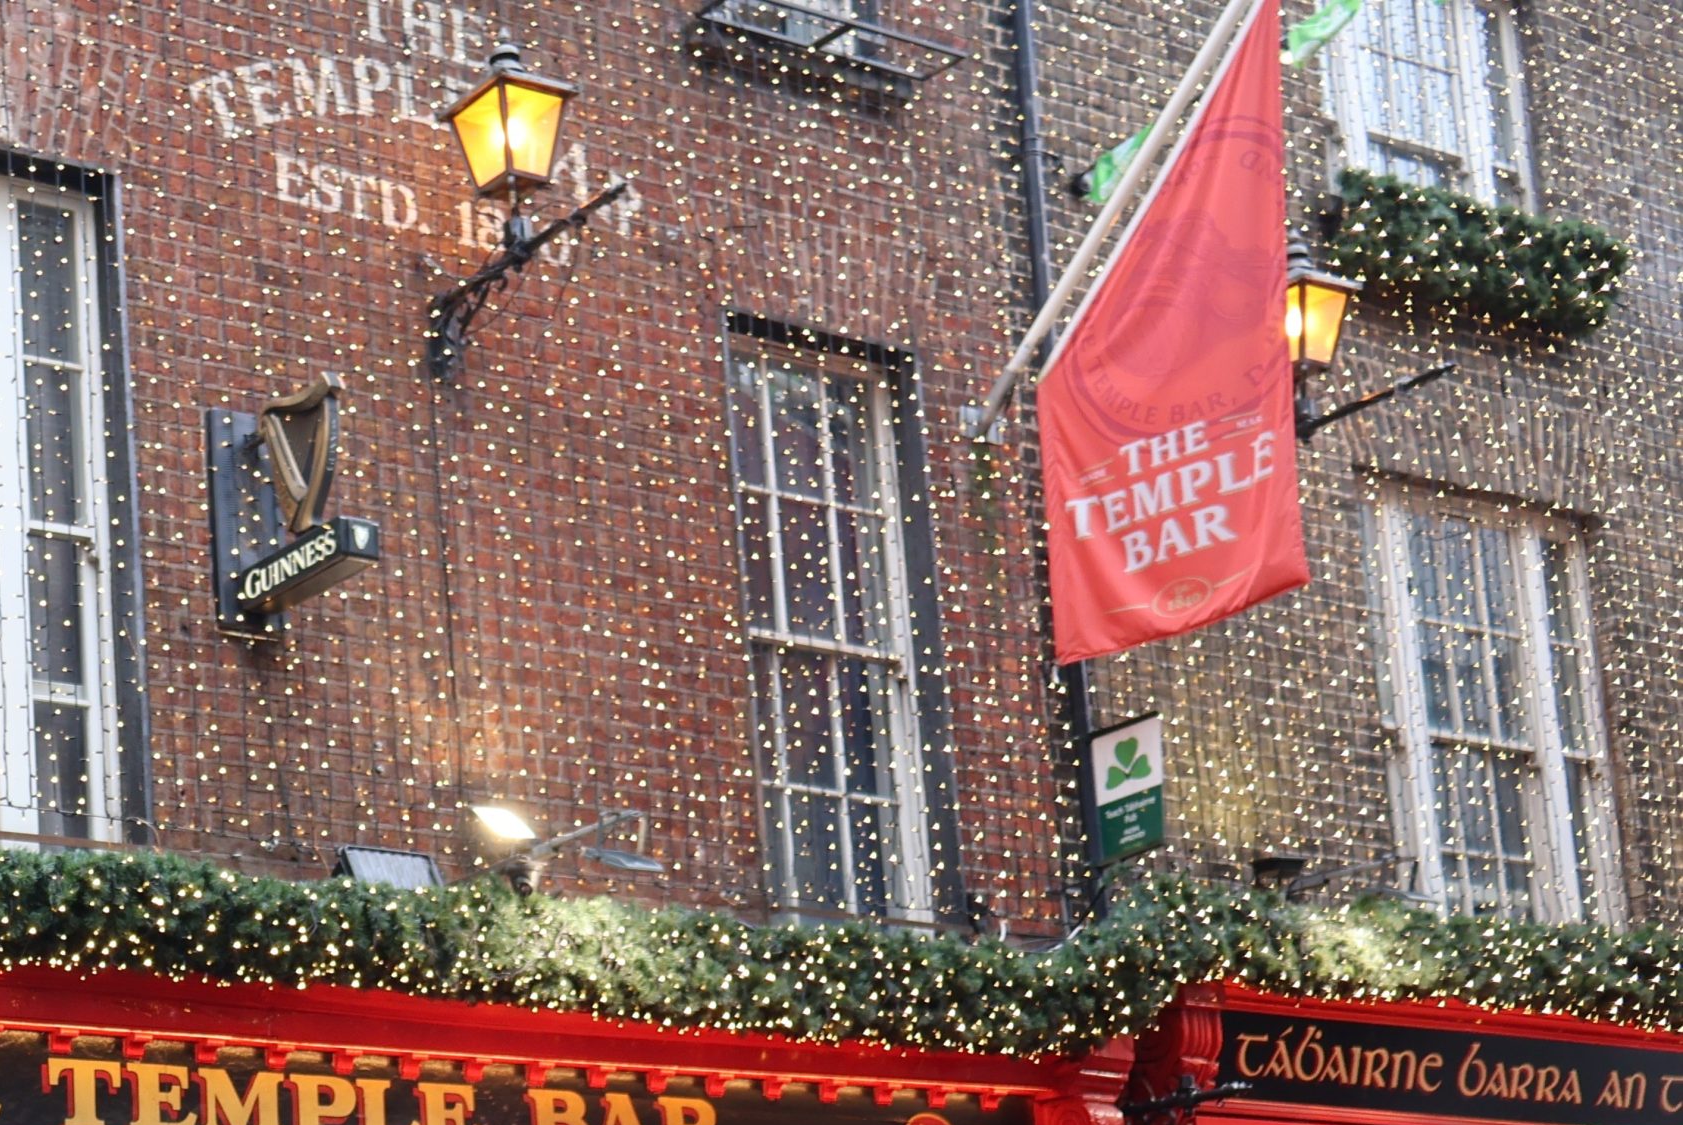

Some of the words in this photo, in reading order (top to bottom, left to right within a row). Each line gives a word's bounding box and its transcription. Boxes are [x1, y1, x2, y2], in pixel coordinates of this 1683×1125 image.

[276, 152, 430, 236] ESTD.
[457, 199, 570, 266] 180
[1119, 421, 1211, 477] THE
[1065, 430, 1276, 542] TEMPLE
[245, 530, 336, 598] GUINNESS
[1121, 504, 1239, 574] BAR
